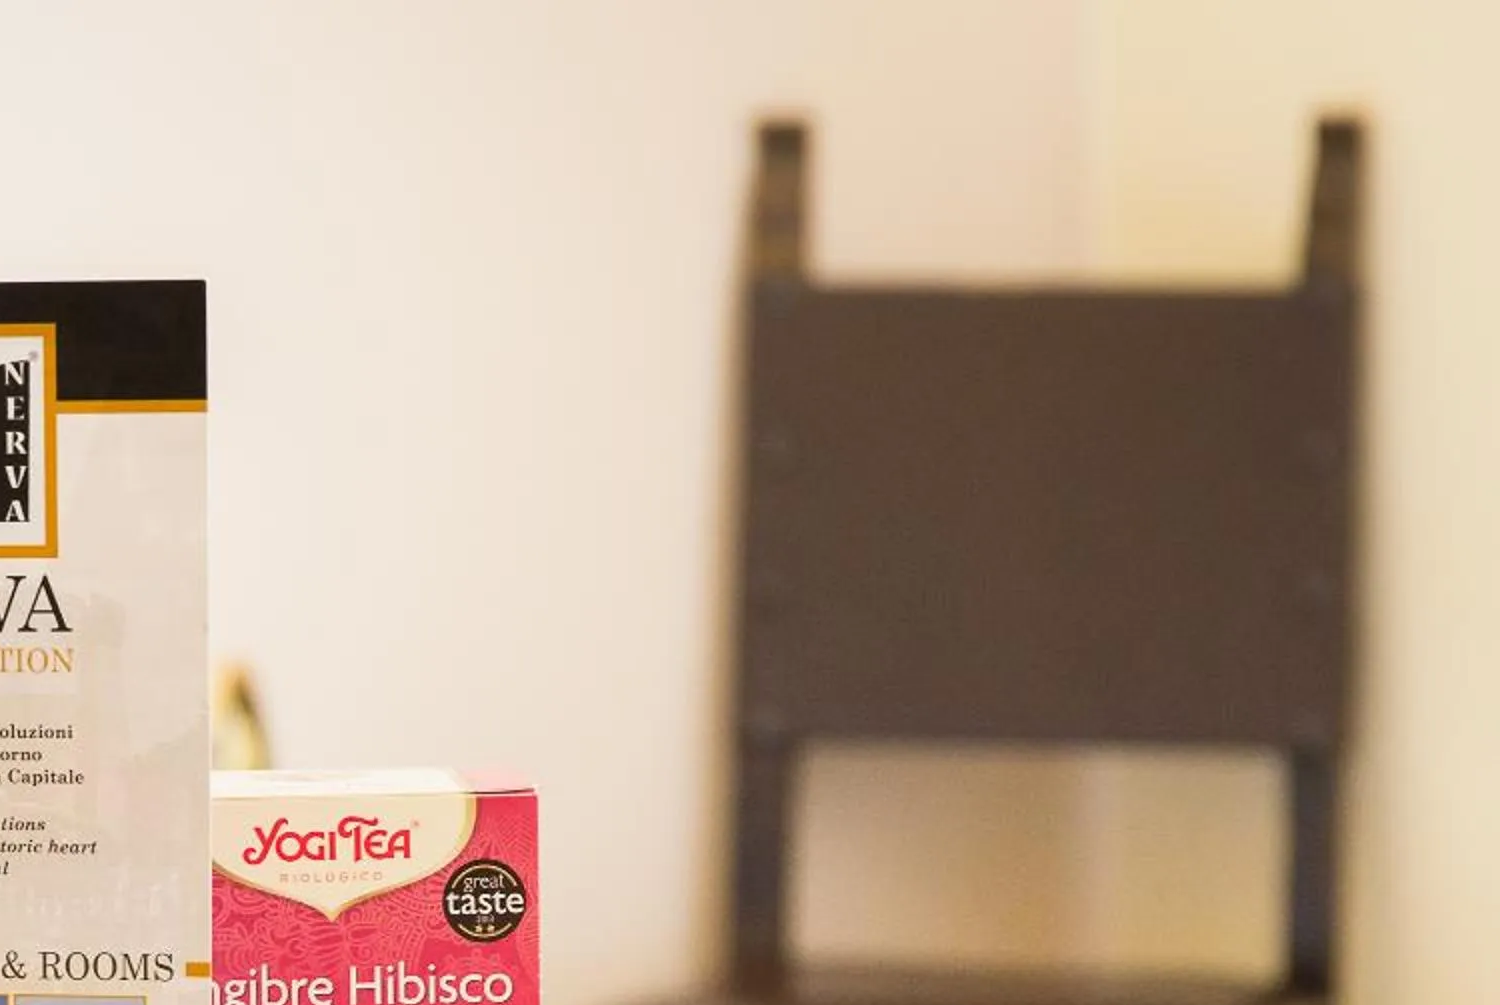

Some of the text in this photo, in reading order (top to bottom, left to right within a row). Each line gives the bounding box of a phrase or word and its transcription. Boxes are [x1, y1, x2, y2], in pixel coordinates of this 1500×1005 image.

[4, 361, 28, 522] NERVA
[7, 768, 85, 787] Capitale
[47, 838, 97, 854] heart
[463, 873, 506, 893] great
[446, 890, 525, 915] taste
[1, 950, 28, 980] &
[38, 950, 175, 982] ROOMS
